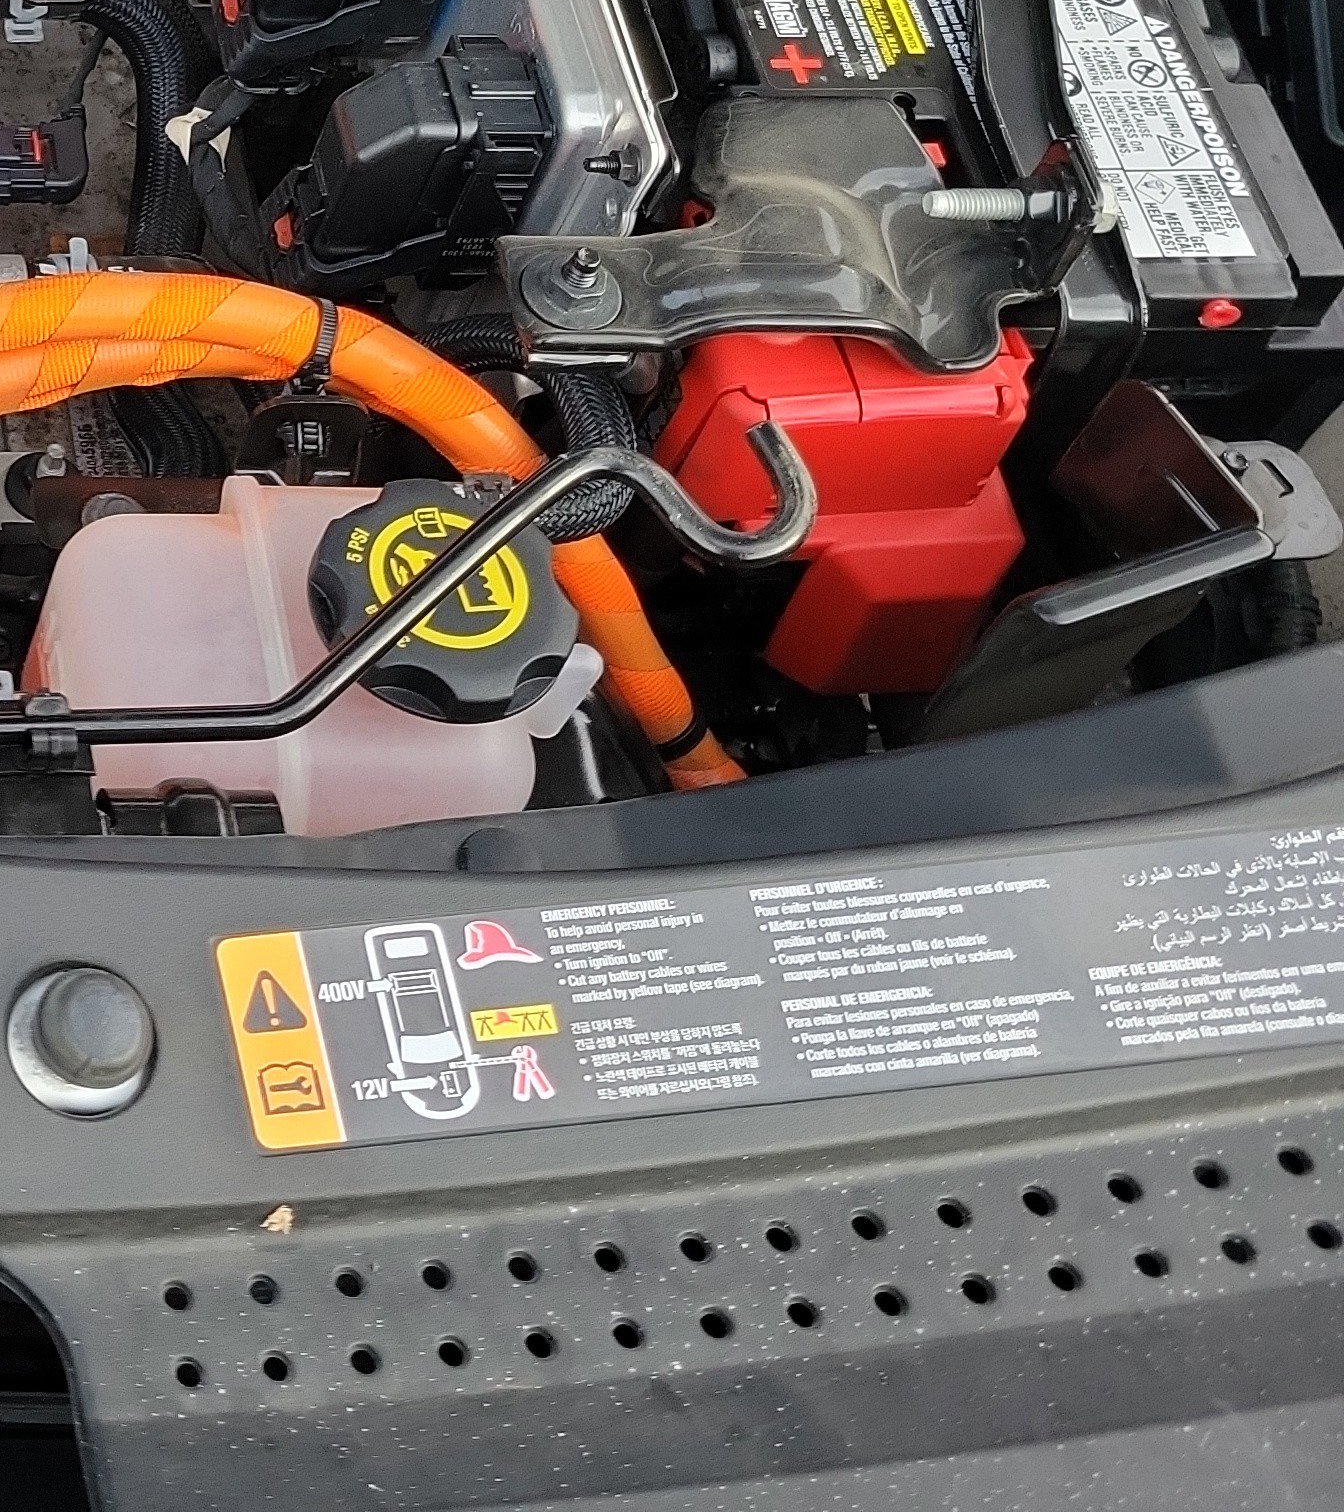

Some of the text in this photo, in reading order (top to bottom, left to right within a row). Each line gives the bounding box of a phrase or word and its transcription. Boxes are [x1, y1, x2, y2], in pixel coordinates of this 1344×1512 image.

[767, 1, 798, 32] AGM
[894, 11, 910, 26] OPEN
[1125, 46, 1141, 57] NO
[1122, 95, 1153, 137] CAN CAUSE
[1137, 95, 1158, 115] ACID
[1152, 36, 1250, 196] DANGER/POISON
[1152, 95, 1184, 137] SULFURIC
[1075, 103, 1102, 139] READ ALL
[1094, 95, 1132, 156] SEVERE BURNS.
[1108, 95, 1144, 151] BLINDNESS OR
[1107, 173, 1131, 201] DO NOT
[1173, 174, 1196, 198] WITH
[1187, 174, 1228, 236] IMMEDIATELY
[1201, 174, 1239, 228] FLUSH EYES
[1142, 202, 1180, 255] HELP FAST.
[1162, 212, 1195, 254] MEDICAL
[1188, 237, 1207, 254] GET
[346, 527, 370, 563] 5 PSI
[539, 904, 607, 922] EMERGENCY
[544, 912, 703, 939] To help avoid personal injury in
[548, 944, 564, 955] an
[561, 952, 641, 970] Turn ignition to
[566, 960, 728, 986] Cut any battery cables or wires
[318, 980, 364, 1002] 400V
[570, 989, 612, 1003] marked
[611, 987, 628, 1001] by
[627, 983, 664, 999] yellow
[663, 982, 689, 995] tape
[688, 978, 714, 993] (see
[351, 1078, 388, 1100] 12V
